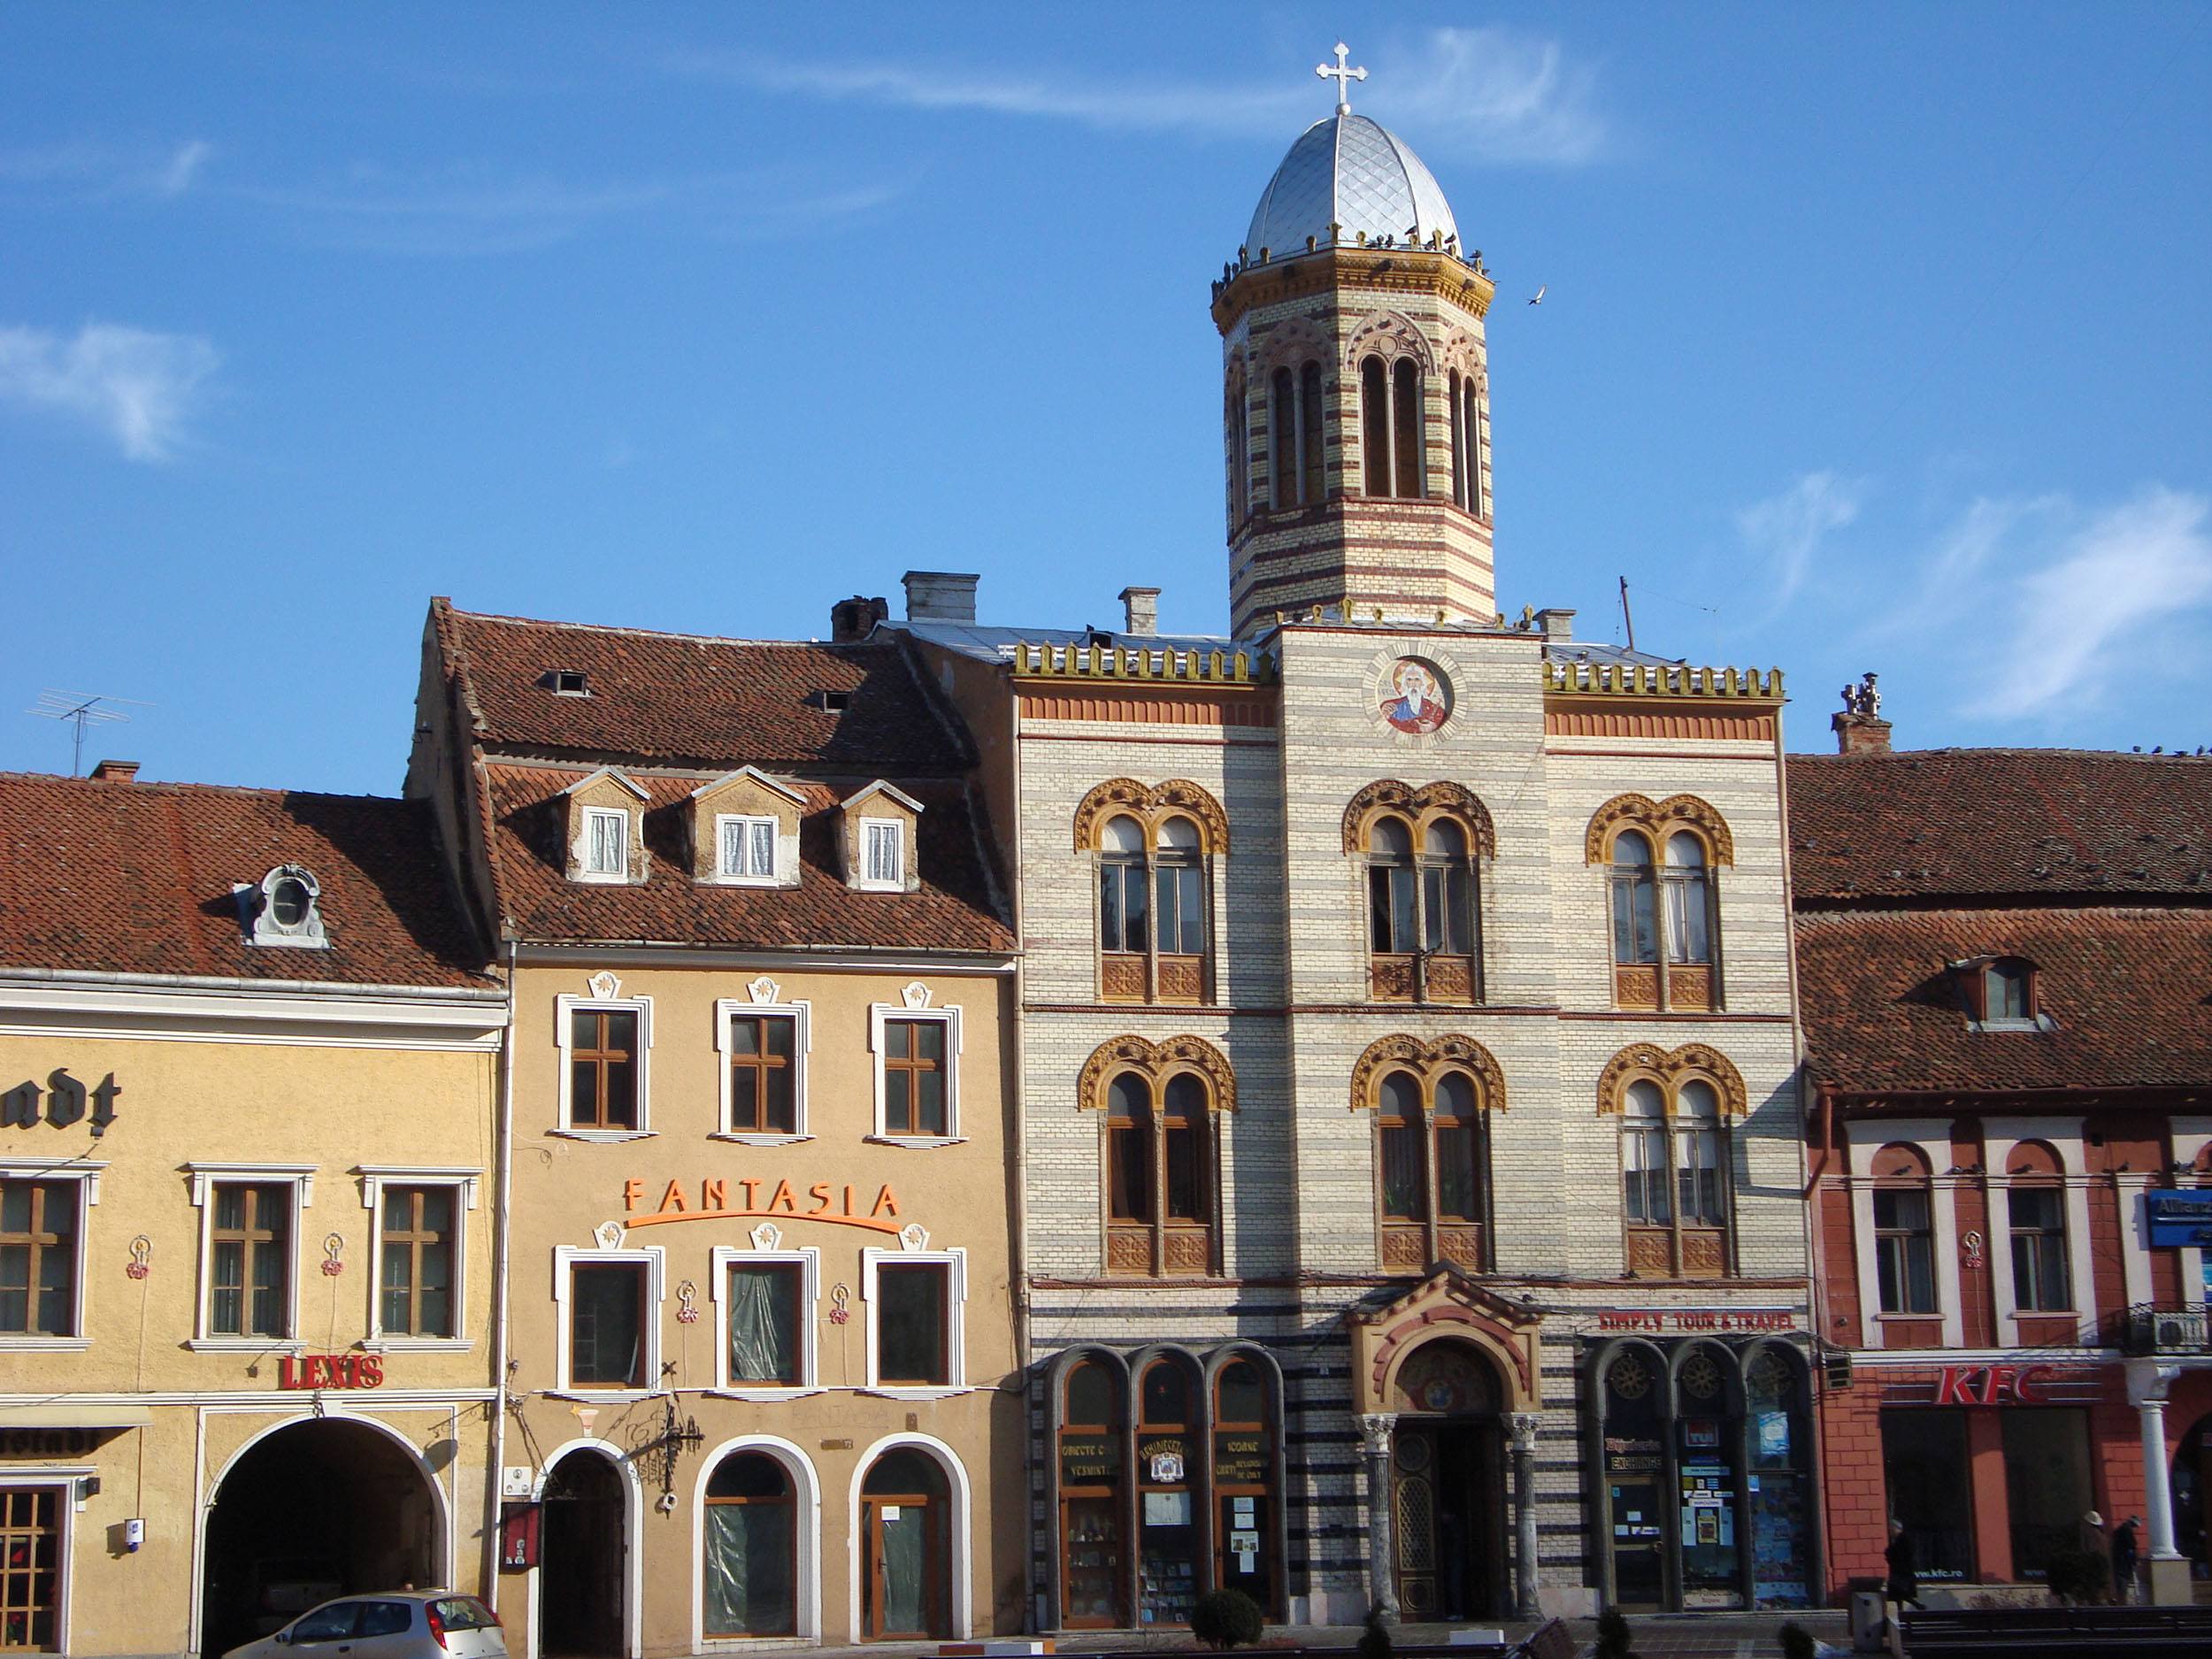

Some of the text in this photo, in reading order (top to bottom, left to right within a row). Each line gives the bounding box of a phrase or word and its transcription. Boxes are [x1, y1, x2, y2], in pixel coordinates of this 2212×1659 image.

[623, 1179, 902, 1217] FANTASIA
[1599, 1312, 1796, 1332] SIMPLY TOUR & TRAVEL
[280, 1355, 384, 1388] LEXIS
[1934, 1365, 2054, 1405] KFC
